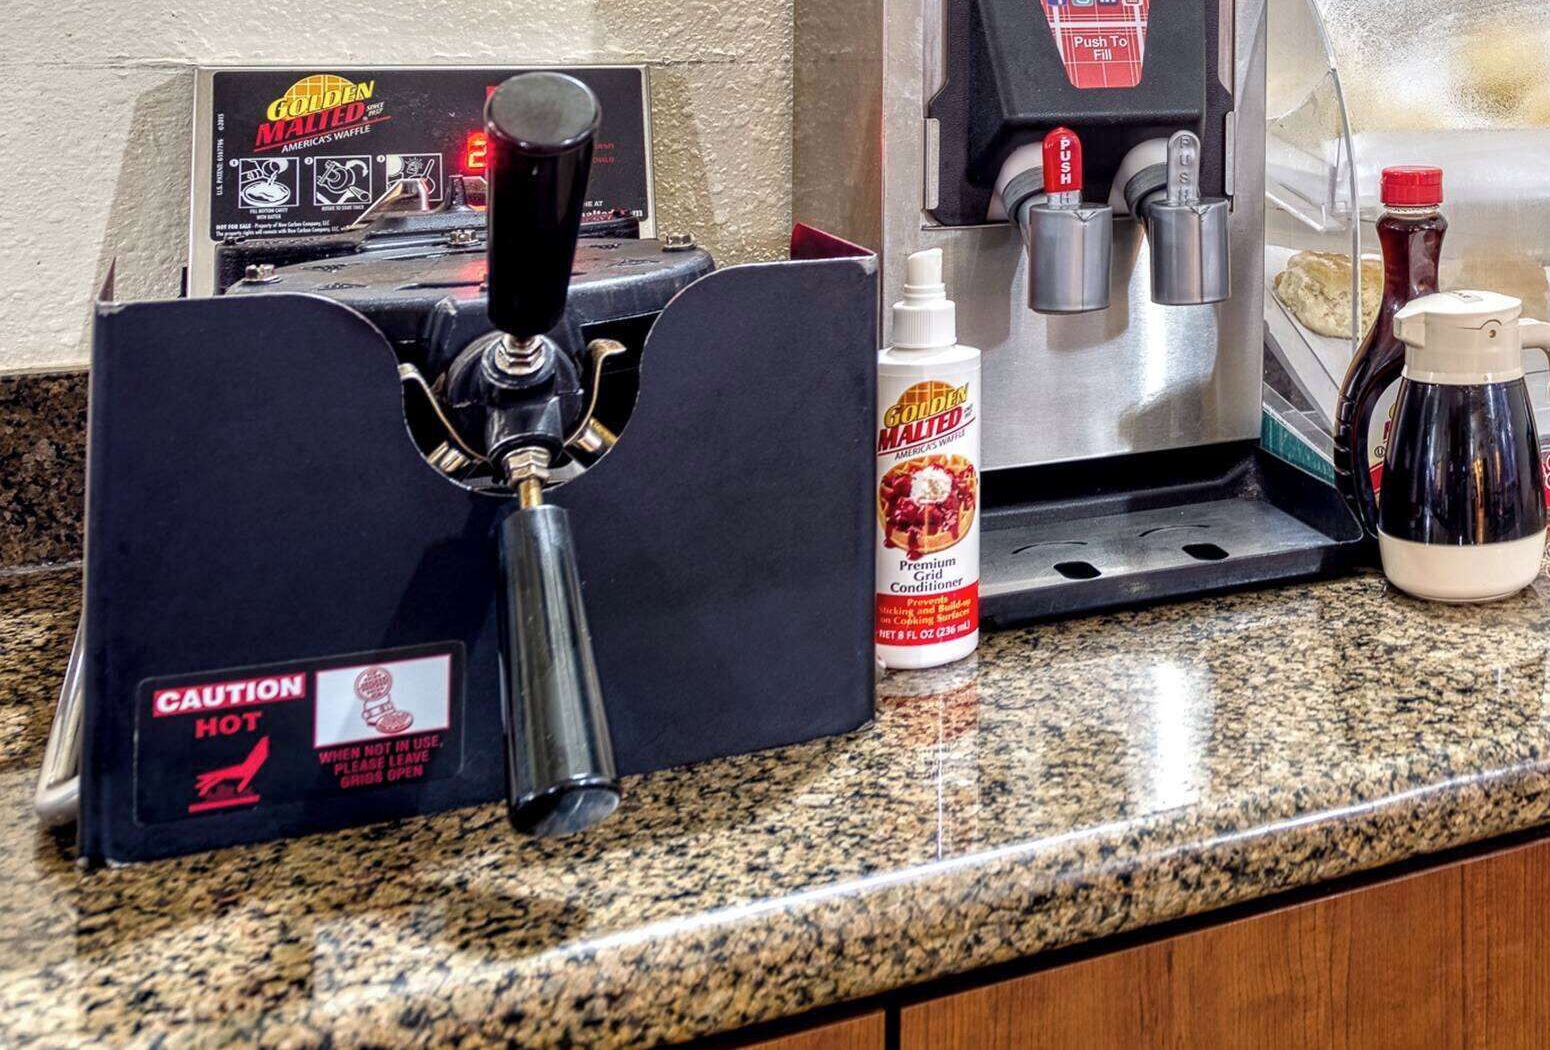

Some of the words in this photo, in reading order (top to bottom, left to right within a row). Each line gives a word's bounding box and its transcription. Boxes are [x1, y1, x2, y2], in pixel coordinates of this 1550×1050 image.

[1074, 36, 1108, 48] Push
[1109, 36, 1128, 47] To
[1093, 49, 1112, 61] Fill
[267, 80, 375, 121] GOLDEN
[256, 101, 365, 146] MALTED
[282, 135, 333, 153] AMERICA'S
[334, 125, 371, 141] WAFFLE
[1060, 137, 1072, 185] PUSH
[884, 382, 970, 429] GOLDEN
[878, 406, 963, 452] MALTED
[895, 442, 938, 461] AMERICA'S
[938, 429, 966, 447] WAFFLE
[899, 557, 956, 570] Premium
[913, 568, 943, 581] Grid
[890, 577, 964, 593] Conditioner
[907, 595, 949, 607] Prevents
[917, 605, 935, 614] and
[893, 615, 935, 626] Cooking
[936, 608, 970, 622] Surfaces
[879, 629, 896, 640] NET
[897, 630, 904, 639] 8
[906, 630, 918, 640] FL
[919, 628, 935, 639] OZ
[936, 624, 956, 638] (236
[155, 675, 304, 714] CAUTION
[194, 711, 263, 739] HOT
[319, 747, 361, 764] WHEN
[364, 741, 392, 756] NOT
[395, 739, 410, 751] IN
[413, 735, 443, 749] USE,
[334, 756, 385, 776] PLEASE
[389, 750, 430, 767] LEAVE
[340, 770, 383, 789] GRIDS
[387, 764, 424, 782] OPEN
